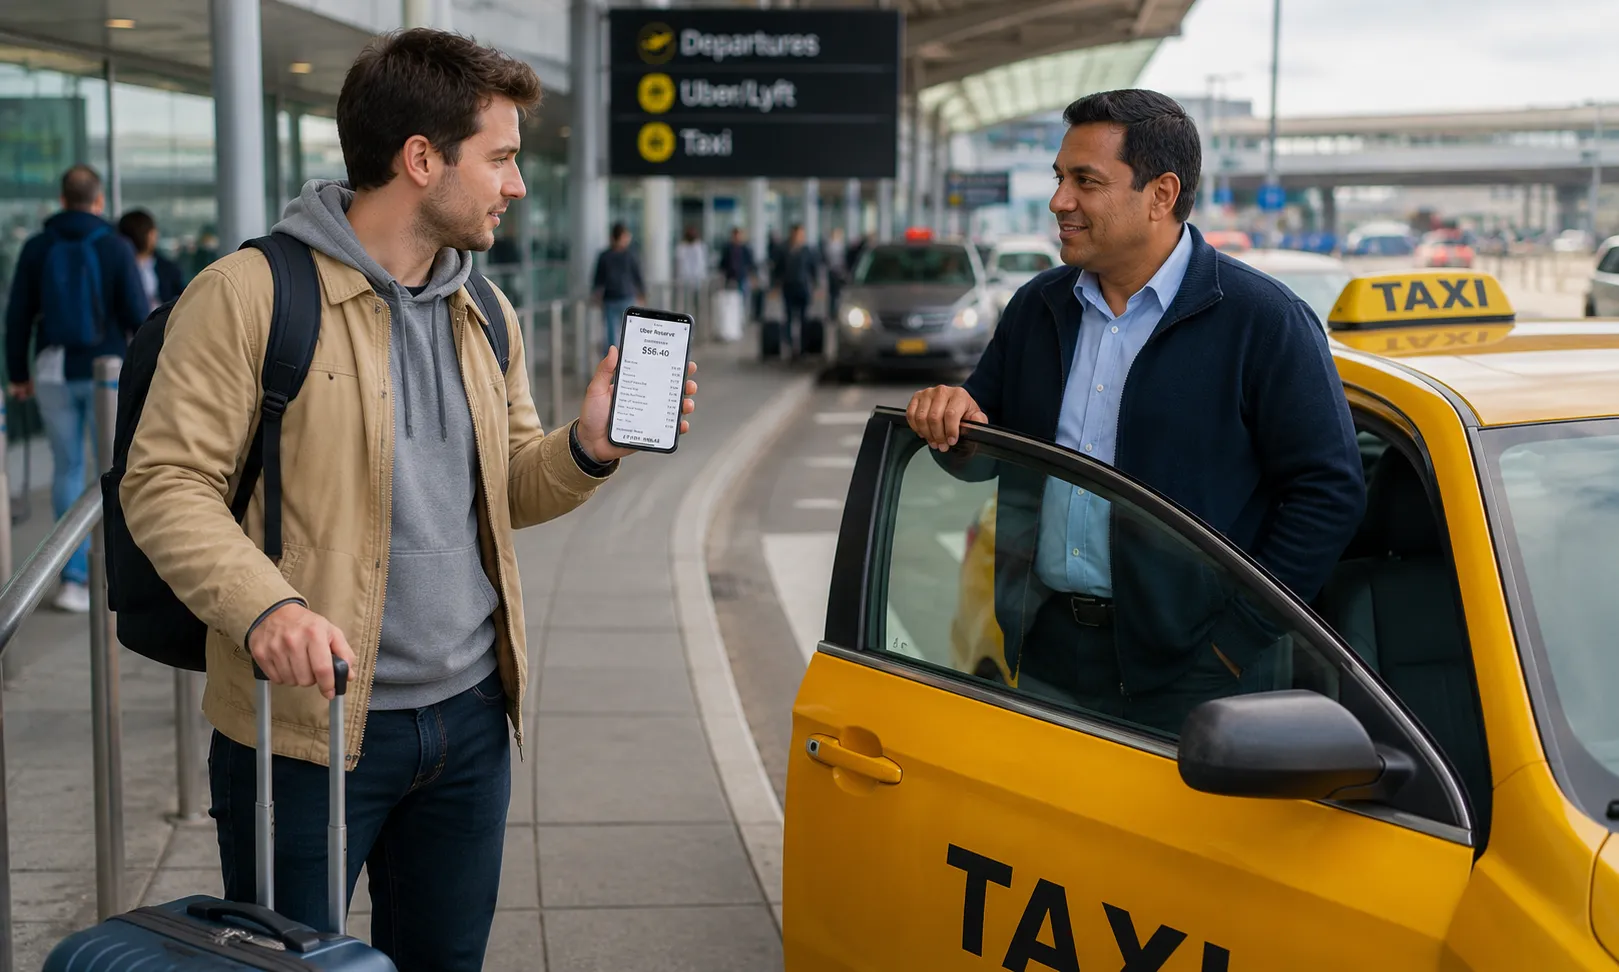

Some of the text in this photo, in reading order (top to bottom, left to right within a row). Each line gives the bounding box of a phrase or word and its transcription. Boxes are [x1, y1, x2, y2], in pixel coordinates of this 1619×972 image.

[680, 29, 819, 61] Departures
[680, 79, 796, 112] Uber/Lyft
[680, 128, 732, 155] Taxi
[1371, 279, 1489, 312] TAXI
